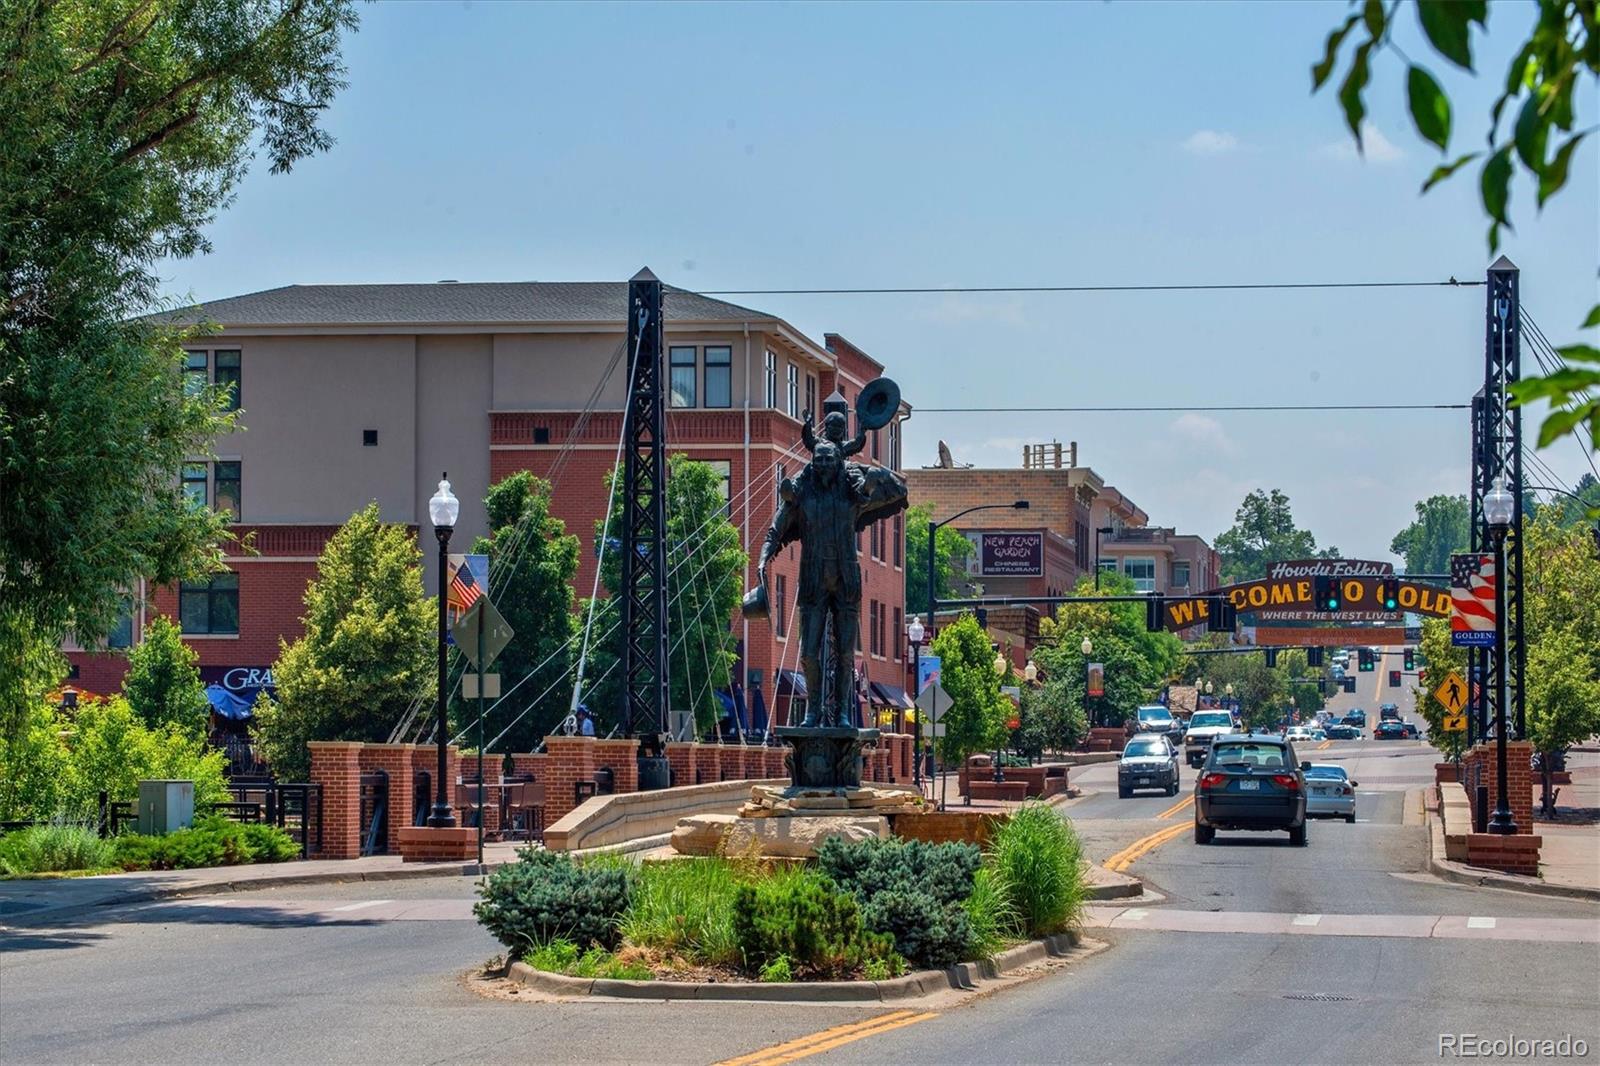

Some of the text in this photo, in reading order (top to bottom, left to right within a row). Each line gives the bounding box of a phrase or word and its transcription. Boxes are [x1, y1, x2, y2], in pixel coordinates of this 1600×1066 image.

[984, 536, 1039, 547] NEW PEACH
[994, 548, 1031, 557] GARDEN
[1272, 562, 1387, 579] Howdy Folks!
[1169, 581, 1312, 625] WECOME
[1262, 611, 1398, 620] WHERE THE WEST LIVES
